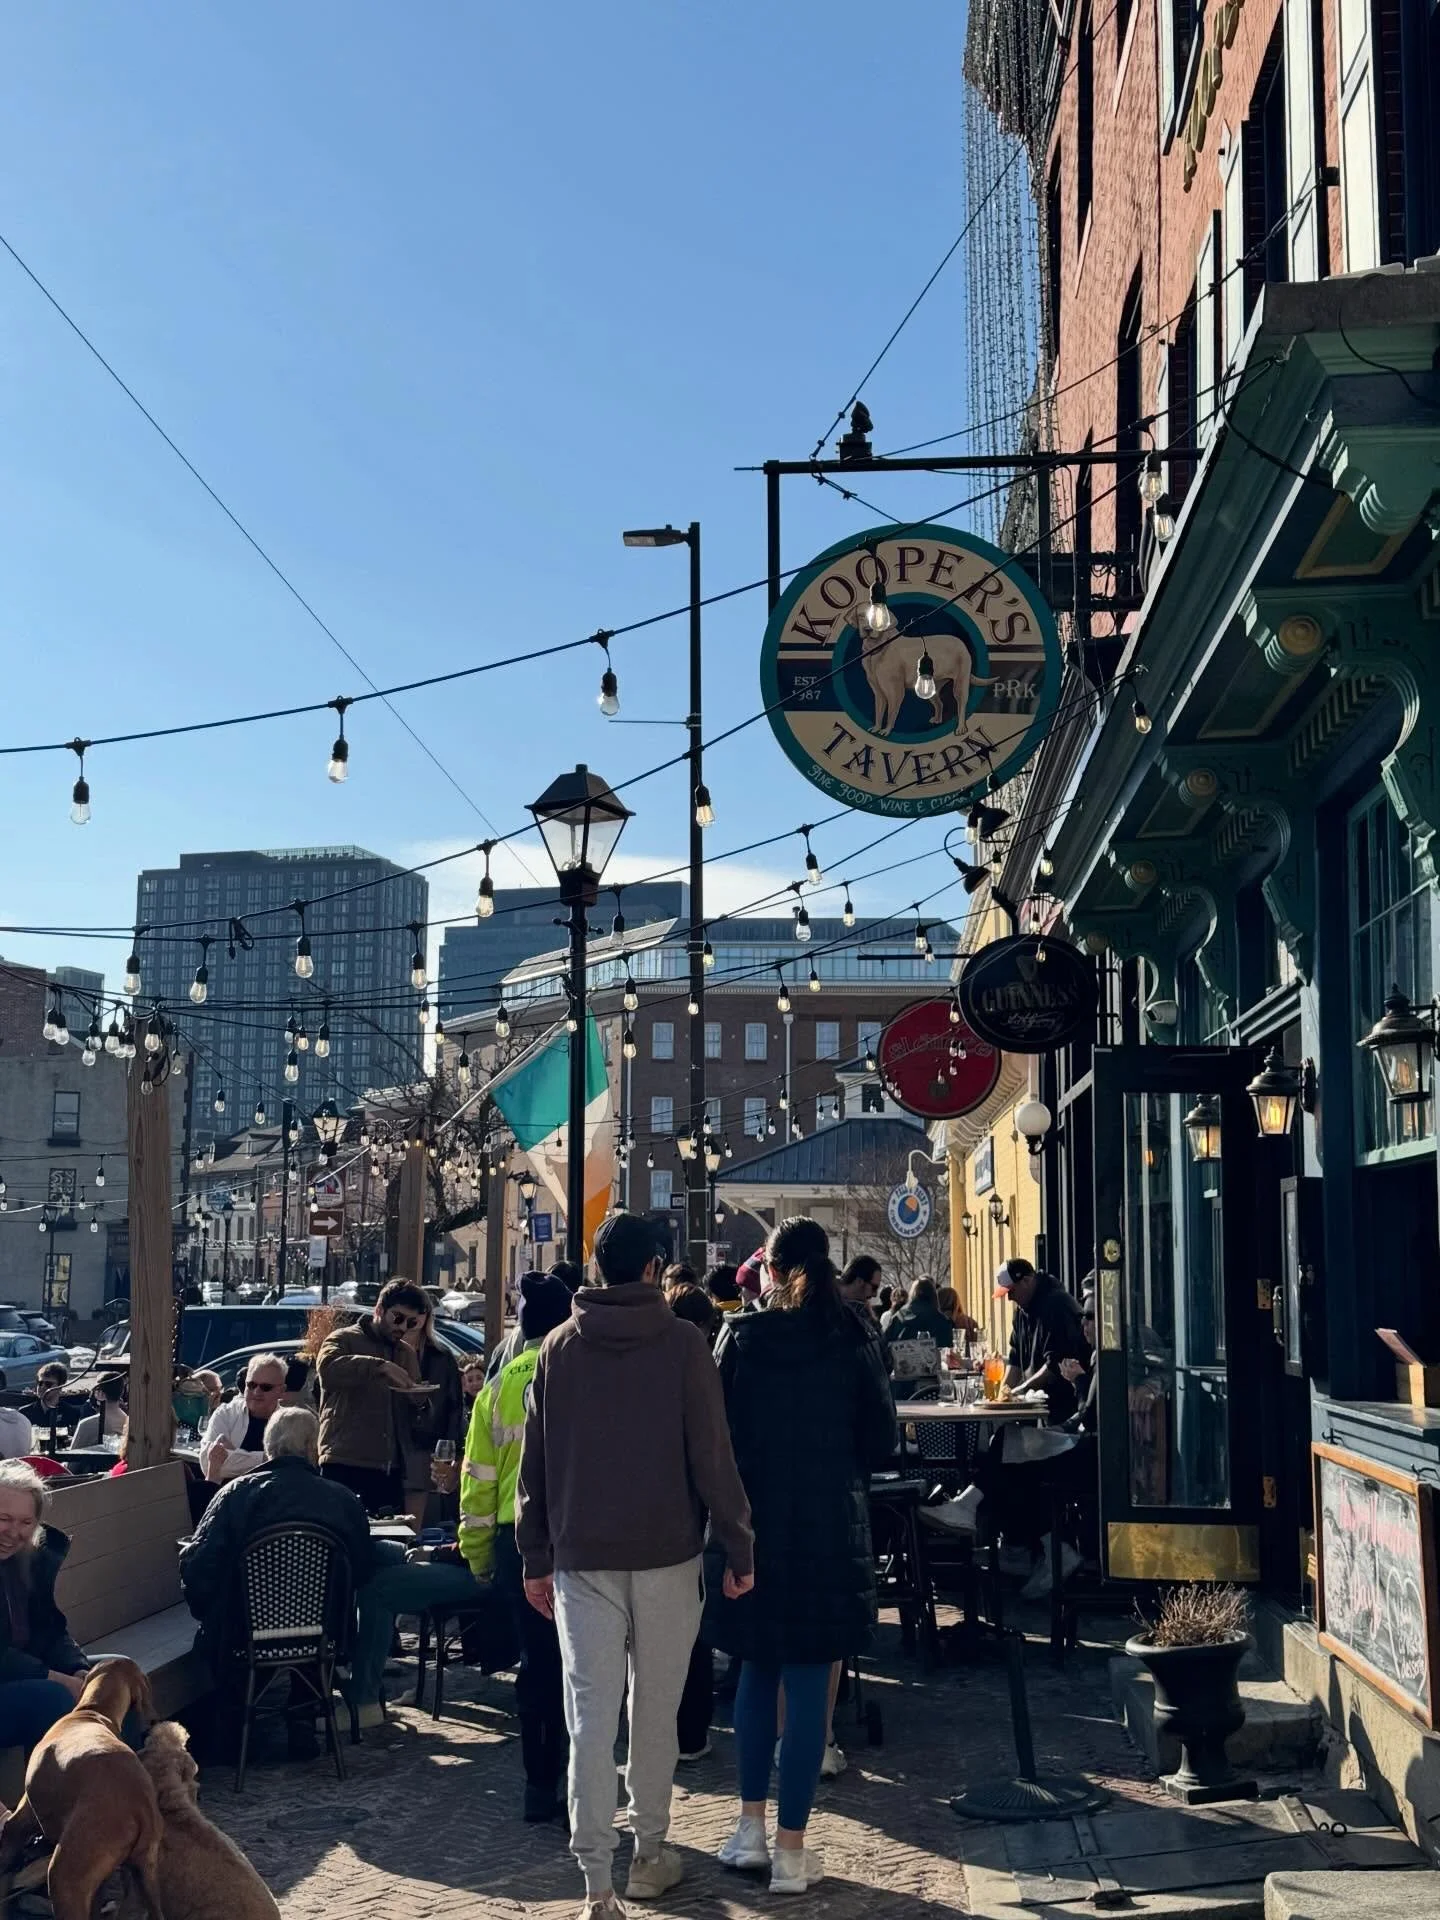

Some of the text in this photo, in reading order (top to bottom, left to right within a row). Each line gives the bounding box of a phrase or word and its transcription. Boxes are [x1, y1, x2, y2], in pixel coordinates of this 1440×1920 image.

[791, 546, 1032, 646] KOOPER'S
[822, 722, 999, 787] TAVERN
[807, 764, 835, 789] FINE
[880, 799, 912, 813] WINE
